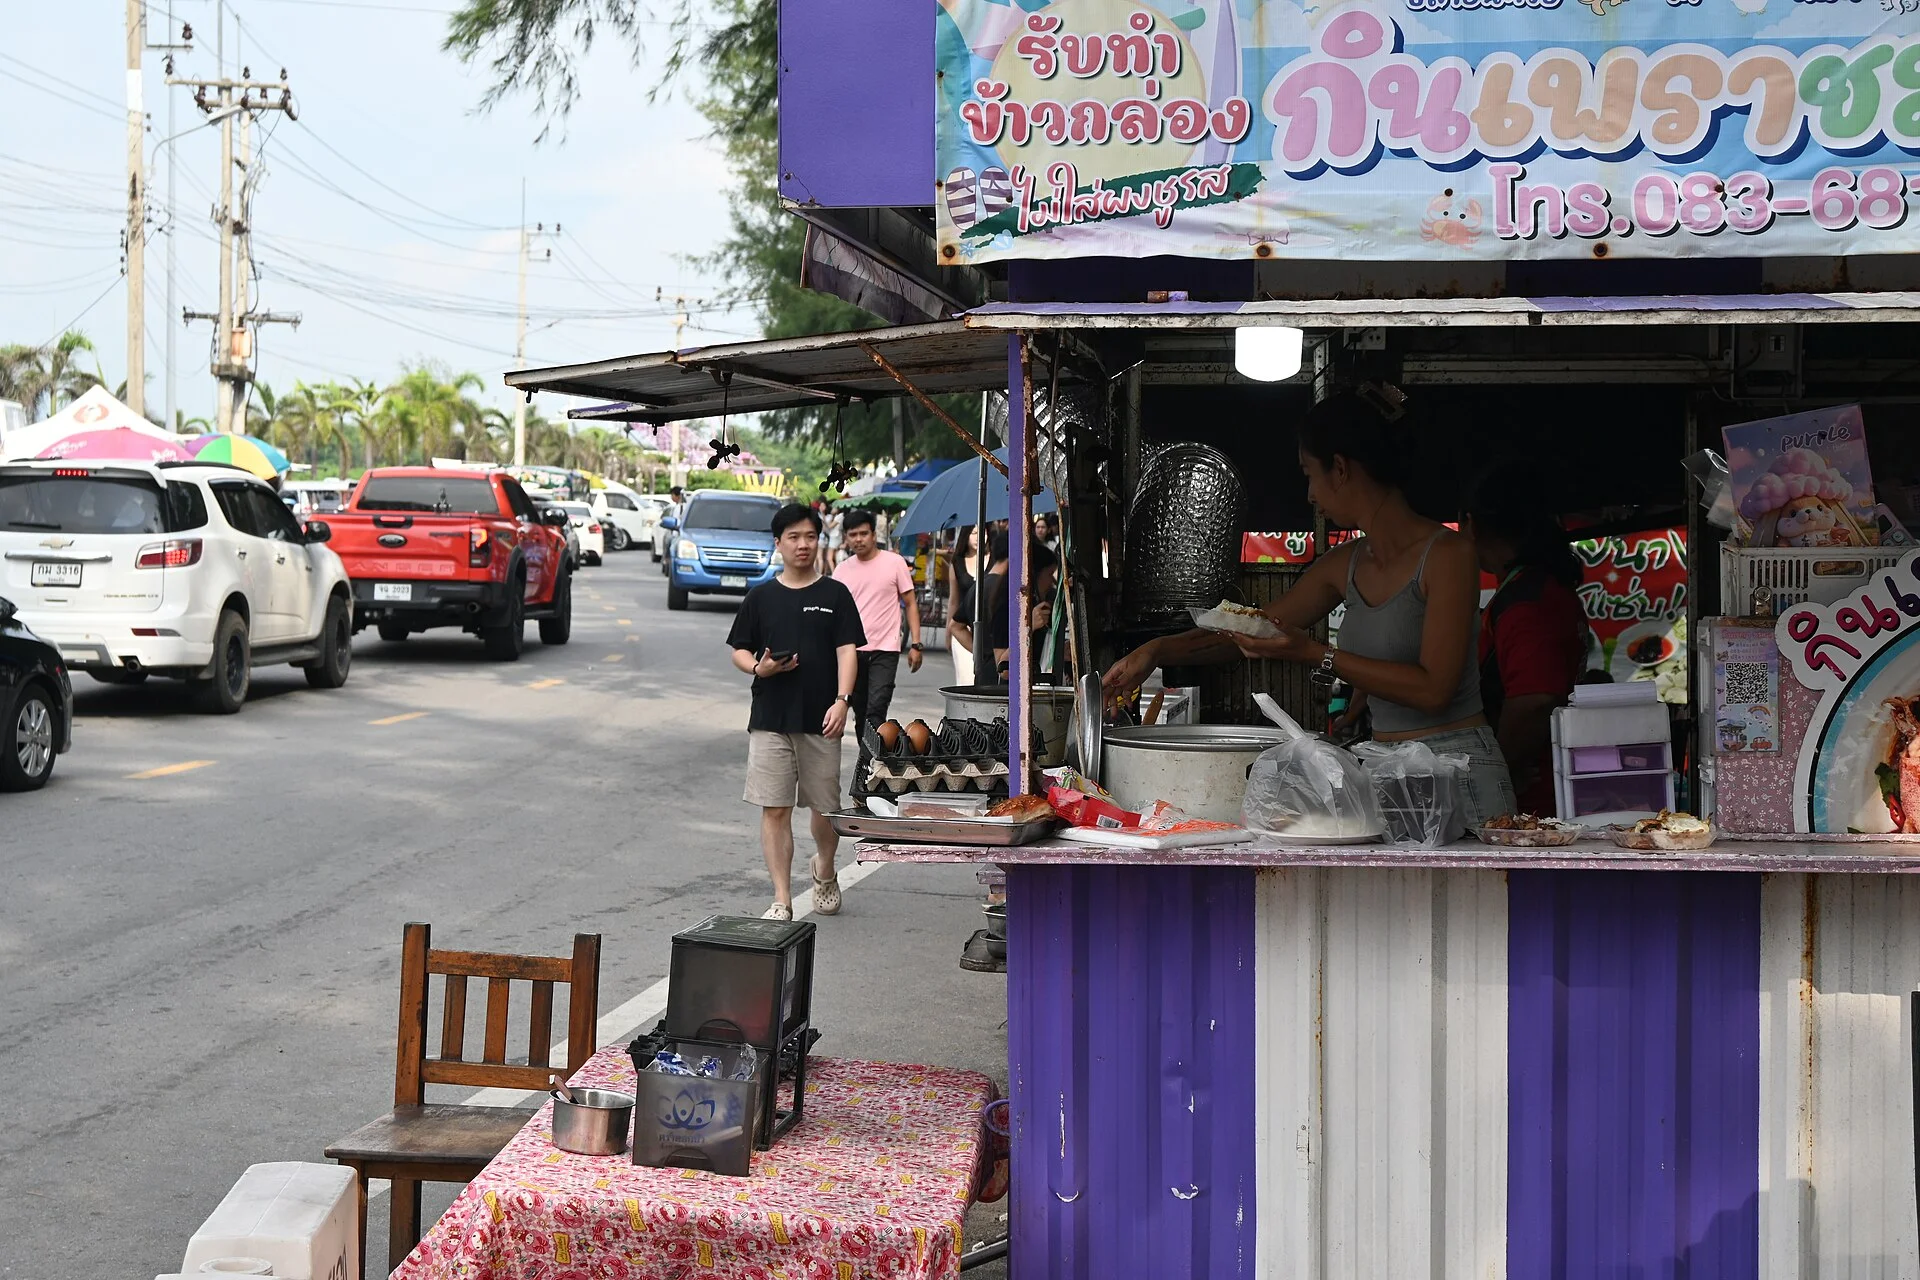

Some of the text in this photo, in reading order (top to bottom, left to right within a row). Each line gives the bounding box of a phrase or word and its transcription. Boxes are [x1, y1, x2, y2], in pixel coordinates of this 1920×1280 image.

[1015, 11, 1183, 80] รับทำ
[959, 78, 1251, 145] ข้าวกล่อง
[1010, 161, 1232, 232] ไม่ใส่ผงชูรส
[1489, 162, 1920, 238] โทร.083-68
